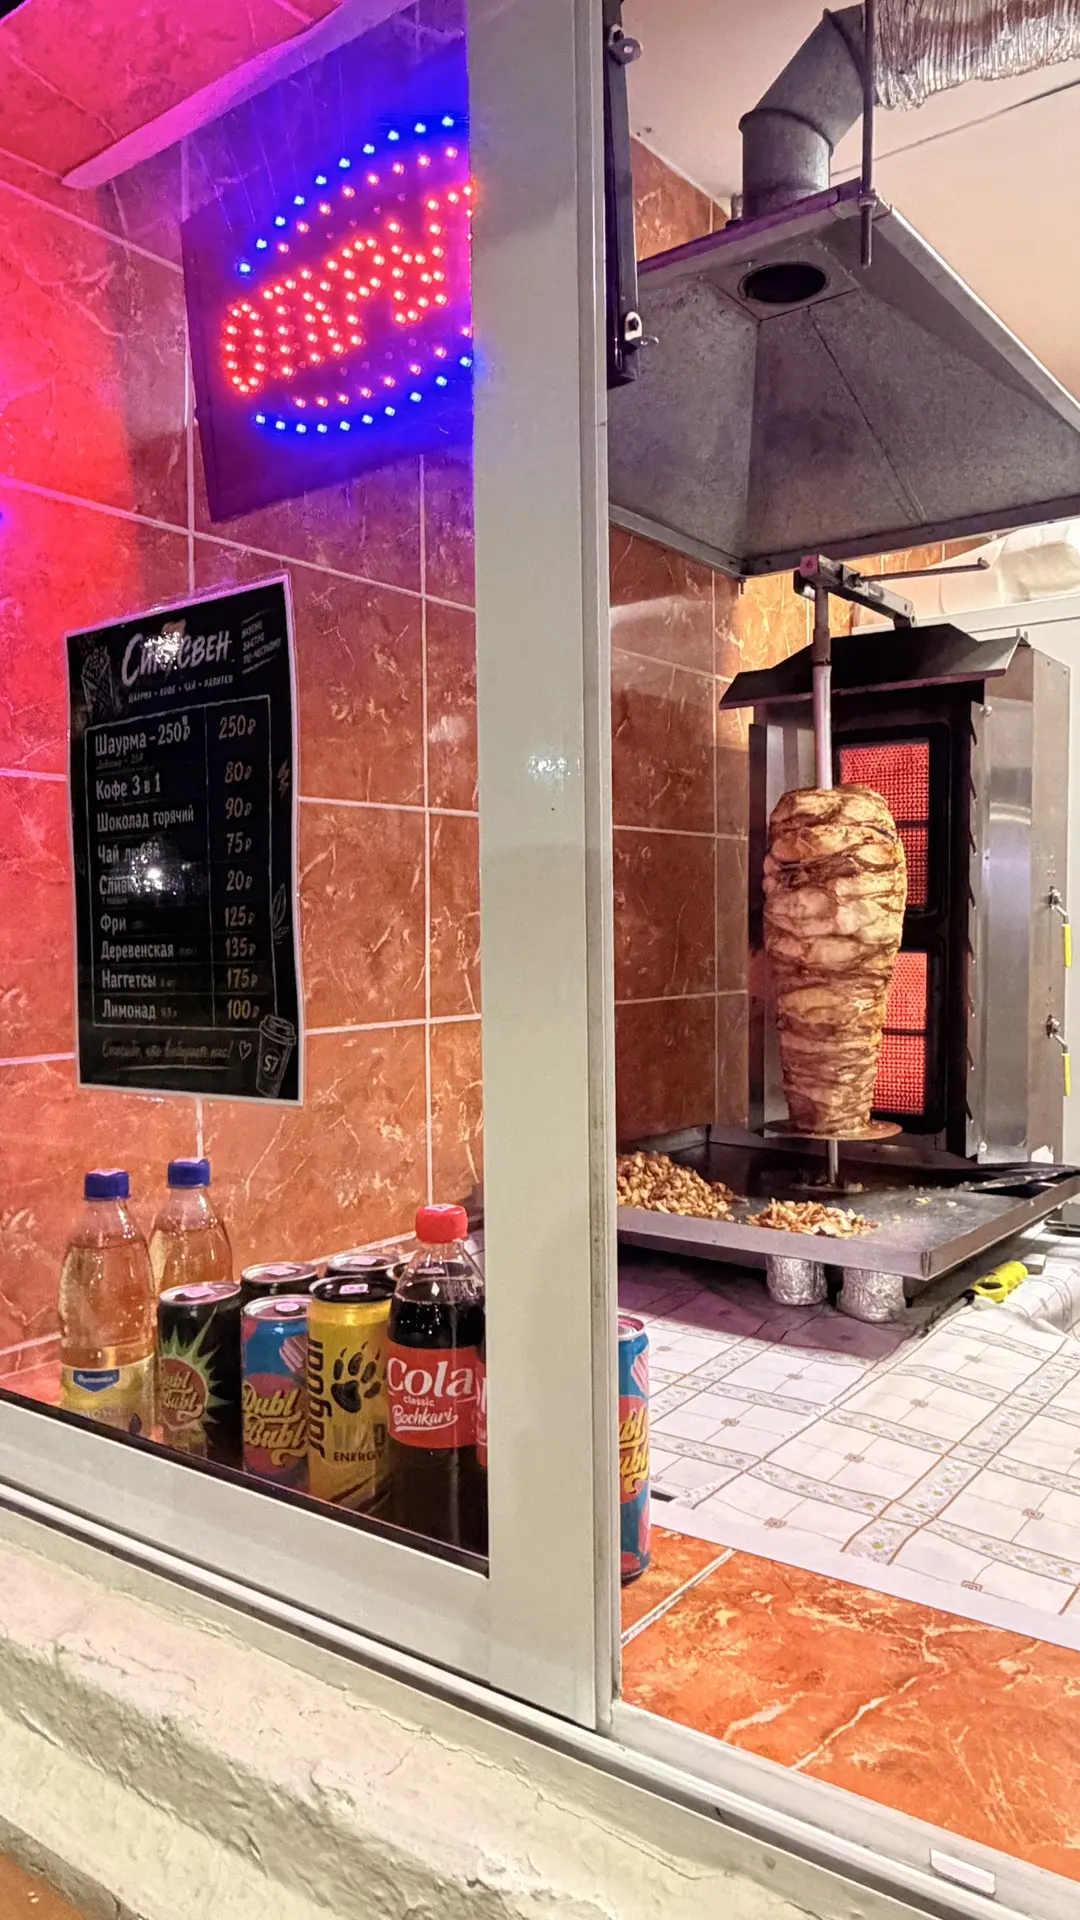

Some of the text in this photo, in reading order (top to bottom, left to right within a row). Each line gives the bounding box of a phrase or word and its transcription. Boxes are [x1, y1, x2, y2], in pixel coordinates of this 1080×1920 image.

[96, 780, 128, 801] Кофе
[132, 774, 141, 796] 3
[144, 782, 150, 794] в
[154, 772, 161, 793] 1
[97, 812, 150, 833] Шоколад
[153, 804, 194, 829] горячий
[98, 844, 120, 865] Чай
[100, 912, 127, 935] Фри
[101, 940, 174, 962] Деревенская
[102, 969, 157, 989] Наггетсы
[102, 998, 156, 1020] Лимонад
[387, 1357, 474, 1398] Cola
[403, 1395, 435, 1407] classic
[391, 1404, 453, 1427] Bochkari
[333, 1450, 385, 1463] ENERGY
